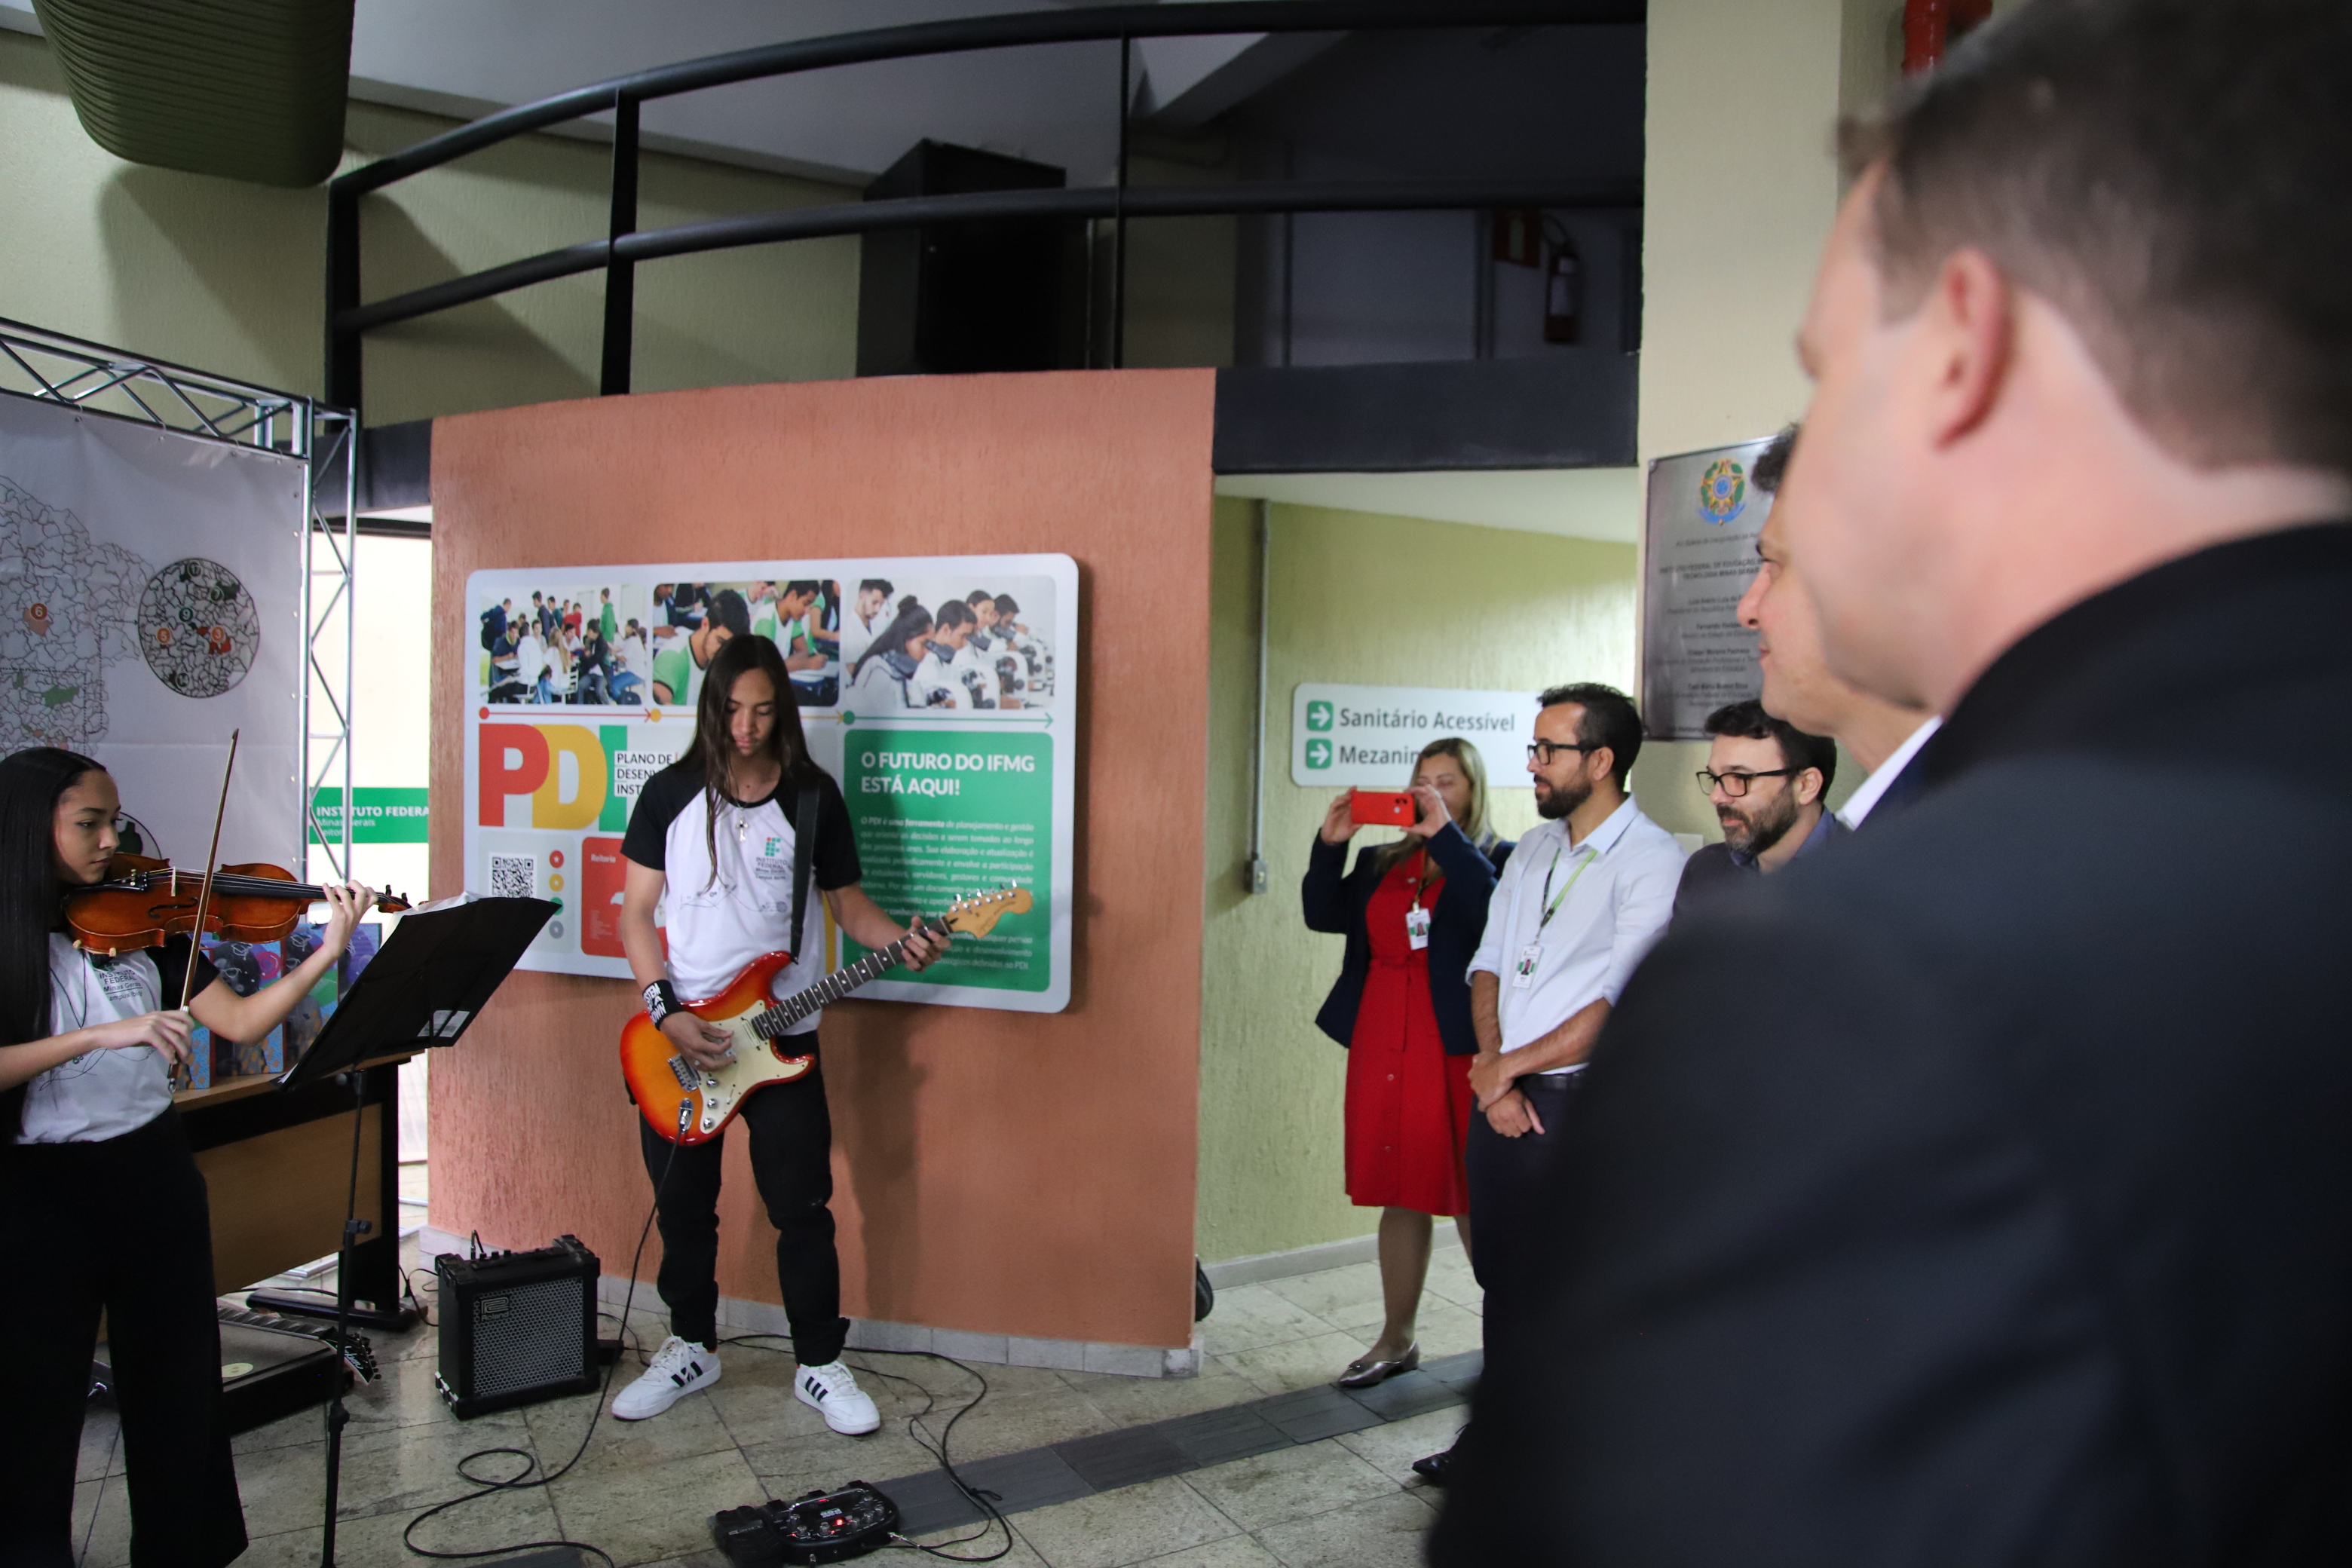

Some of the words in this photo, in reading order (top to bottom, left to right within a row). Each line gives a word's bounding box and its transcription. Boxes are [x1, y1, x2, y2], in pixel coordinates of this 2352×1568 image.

[35, 606, 43, 617] 6
[182, 608, 190, 620] 9
[1340, 708, 1428, 729] Sanitário
[1433, 711, 1515, 731] Acessível
[617, 753, 656, 764] PLANO
[658, 754, 672, 764] DE
[1340, 745, 1419, 764] Mezanin
[862, 752, 875, 768] O
[879, 752, 952, 770] FUTURO
[954, 754, 984, 770] DO
[987, 755, 1035, 772] IFMG
[479, 724, 627, 832] PDI
[617, 784, 642, 795] INST
[862, 774, 905, 794] ESTÁ
[907, 777, 960, 798] AQUI!
[317, 806, 382, 816] INSTTUTO
[385, 806, 429, 816] FEDERA
[100, 969, 135, 979] INSTITUTO
[105, 975, 136, 985] FEDERAL
[109, 993, 130, 1001] ampus
[482, 1312, 509, 1321] Roland
